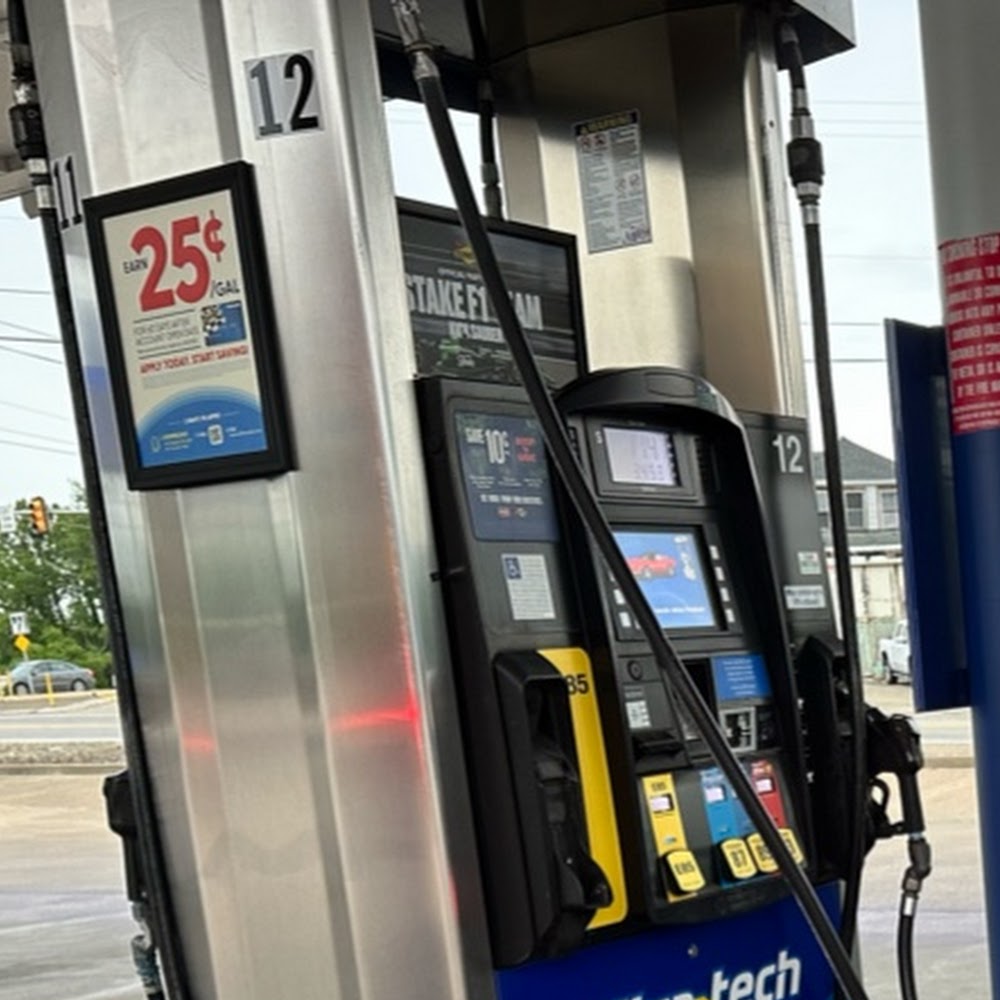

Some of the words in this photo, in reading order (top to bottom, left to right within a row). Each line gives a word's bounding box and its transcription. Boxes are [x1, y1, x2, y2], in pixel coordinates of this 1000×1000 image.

[251, 54, 319, 137] 12
[53, 156, 82, 229] 11
[122, 258, 149, 274] EARN
[772, 433, 804, 473] 12
